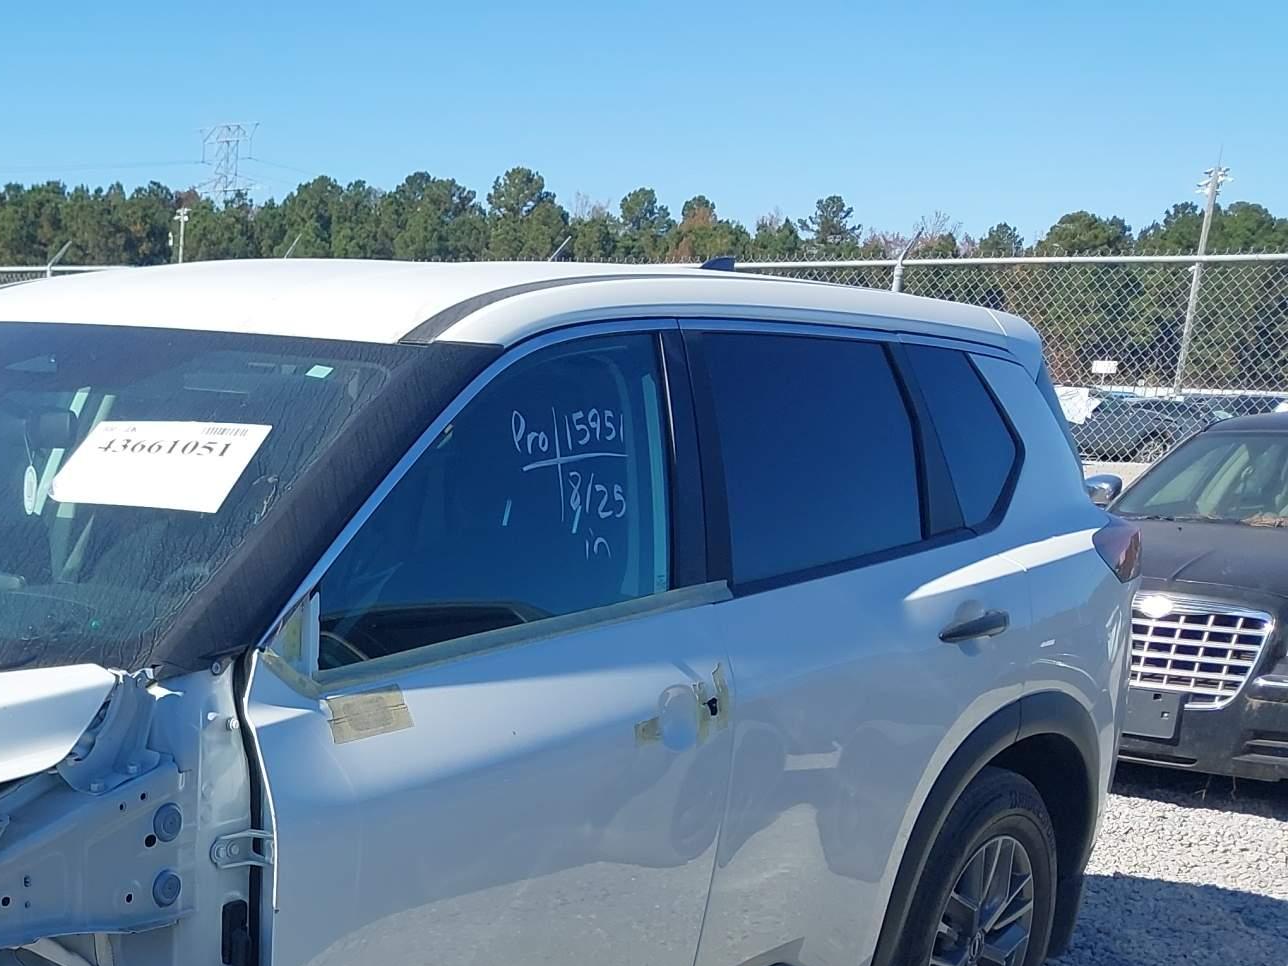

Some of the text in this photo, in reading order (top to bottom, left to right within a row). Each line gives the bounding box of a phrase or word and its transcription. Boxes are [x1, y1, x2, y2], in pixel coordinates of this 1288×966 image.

[98, 438, 232, 457] 43661051
[510, 408, 625, 454] Pro 15951
[567, 471, 627, 520] 8/25
